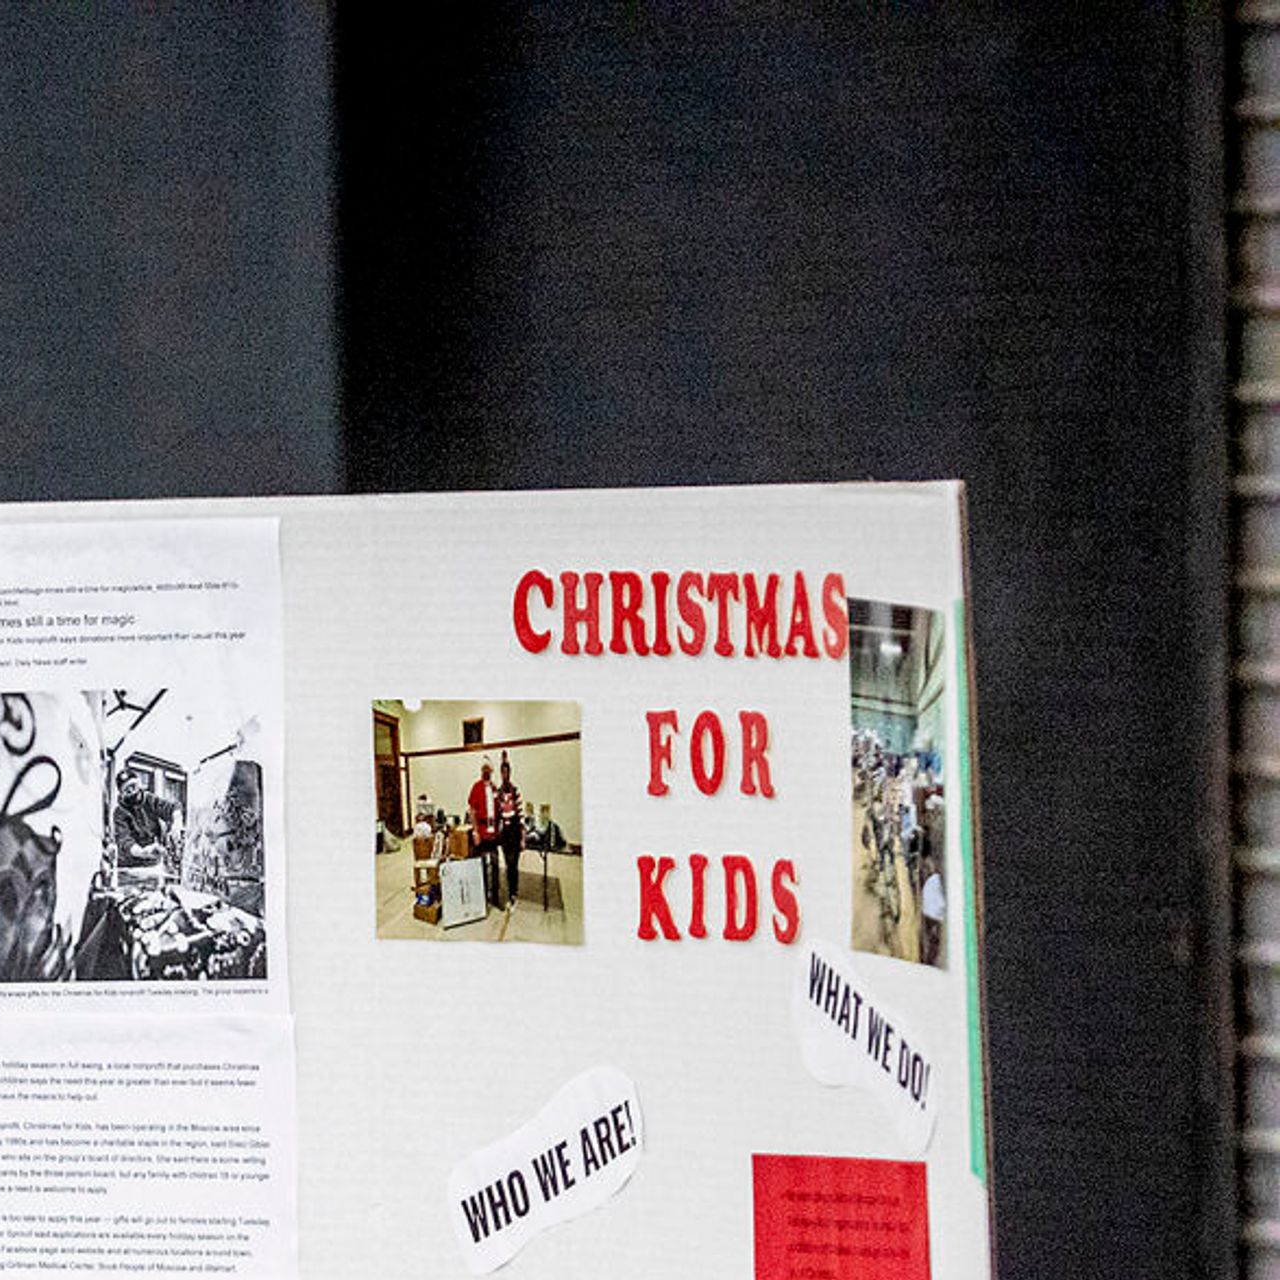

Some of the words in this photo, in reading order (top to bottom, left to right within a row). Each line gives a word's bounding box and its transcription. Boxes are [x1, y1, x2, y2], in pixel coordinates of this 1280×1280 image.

[25, 616, 43, 626] still
[56, 615, 80, 625] time
[83, 615, 97, 625] for
[101, 614, 135, 627] magic
[513, 569, 850, 661] CHRISTMAS
[645, 710, 775, 798] FOR
[636, 853, 800, 945] KIDS
[809, 951, 863, 1040] WHAT
[867, 1006, 894, 1073] WE
[898, 1039, 930, 1110] DO!
[461, 1170, 530, 1243] WHO
[532, 1140, 576, 1202] WE
[579, 1100, 637, 1178] ARE!
